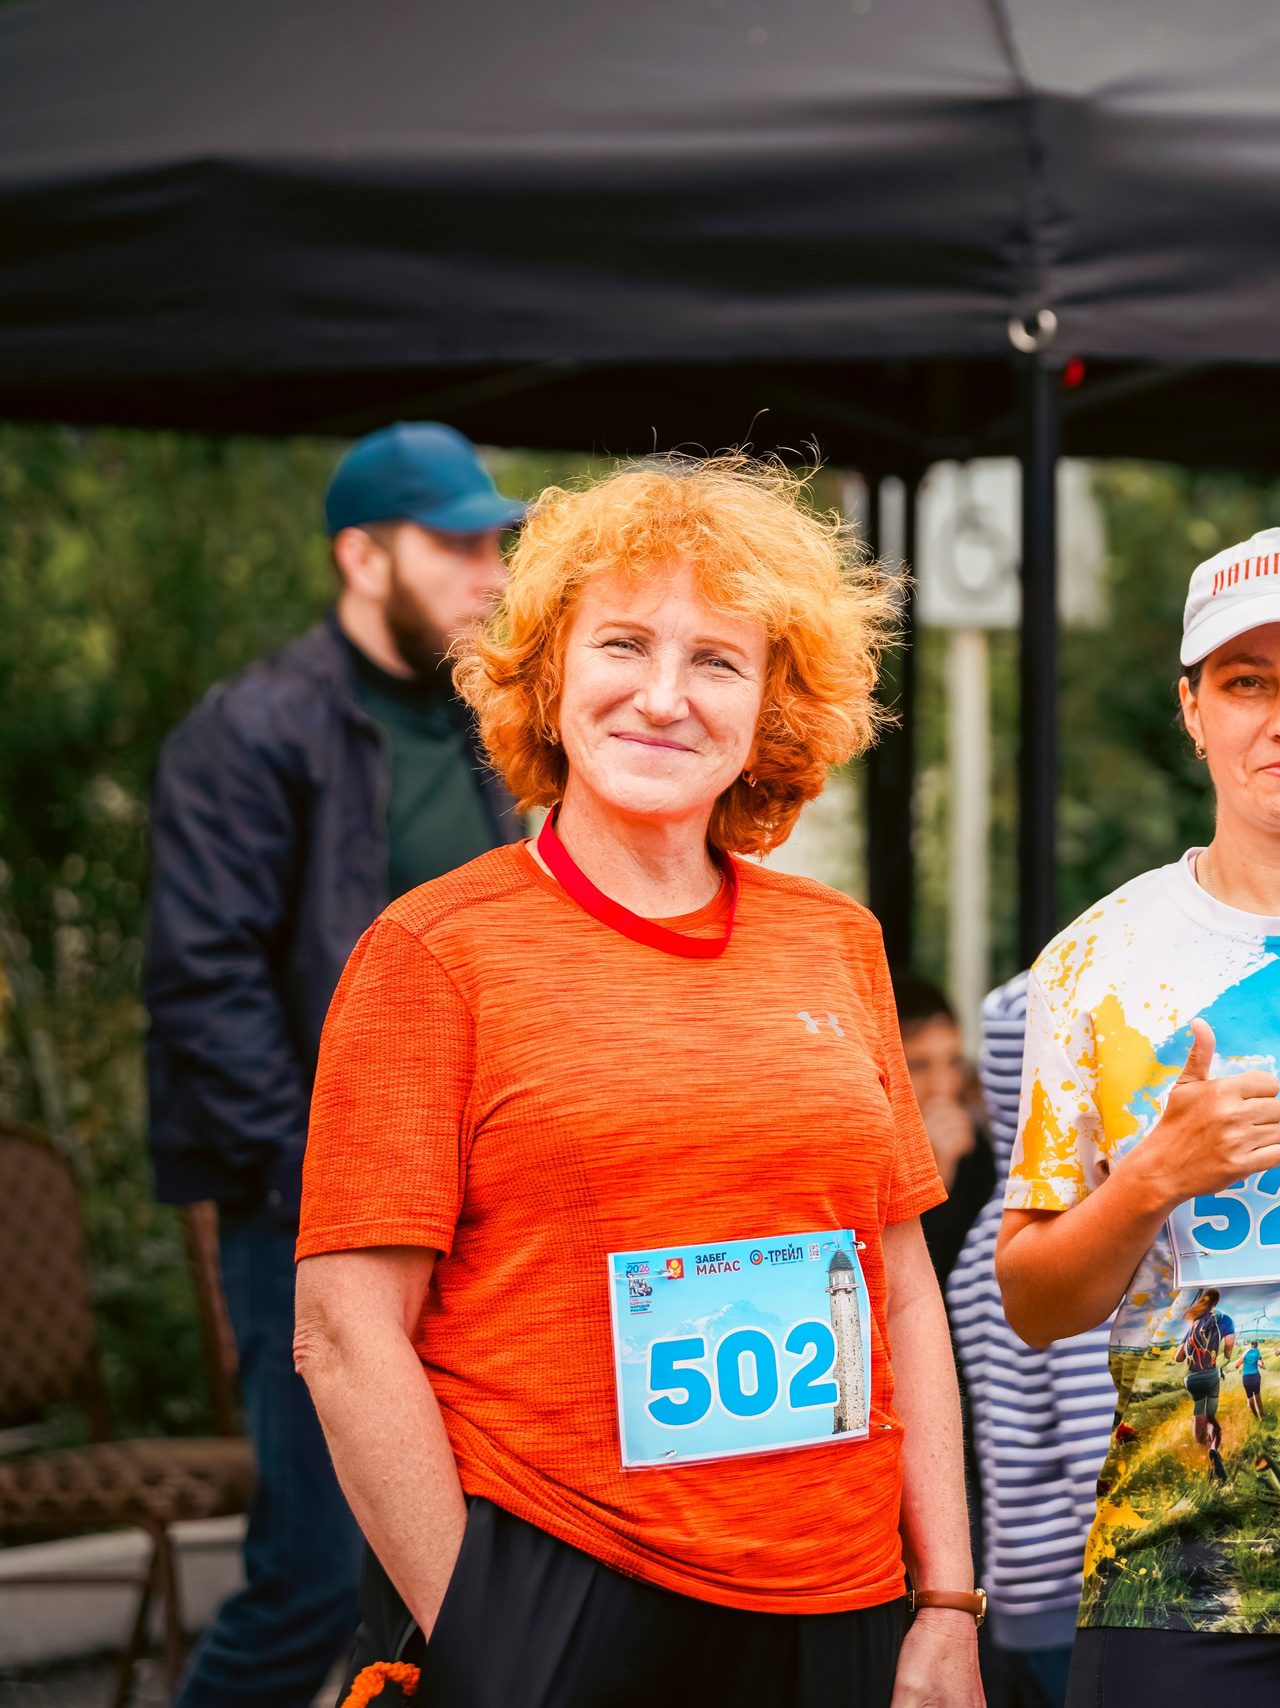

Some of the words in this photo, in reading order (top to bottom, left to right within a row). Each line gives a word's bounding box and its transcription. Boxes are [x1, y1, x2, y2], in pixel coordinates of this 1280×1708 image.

[695, 1252, 727, 1264] ЗАБЕГ
[627, 1263, 650, 1274] 2026
[696, 1260, 741, 1275] МАГАС
[647, 1320, 838, 1426] 502
